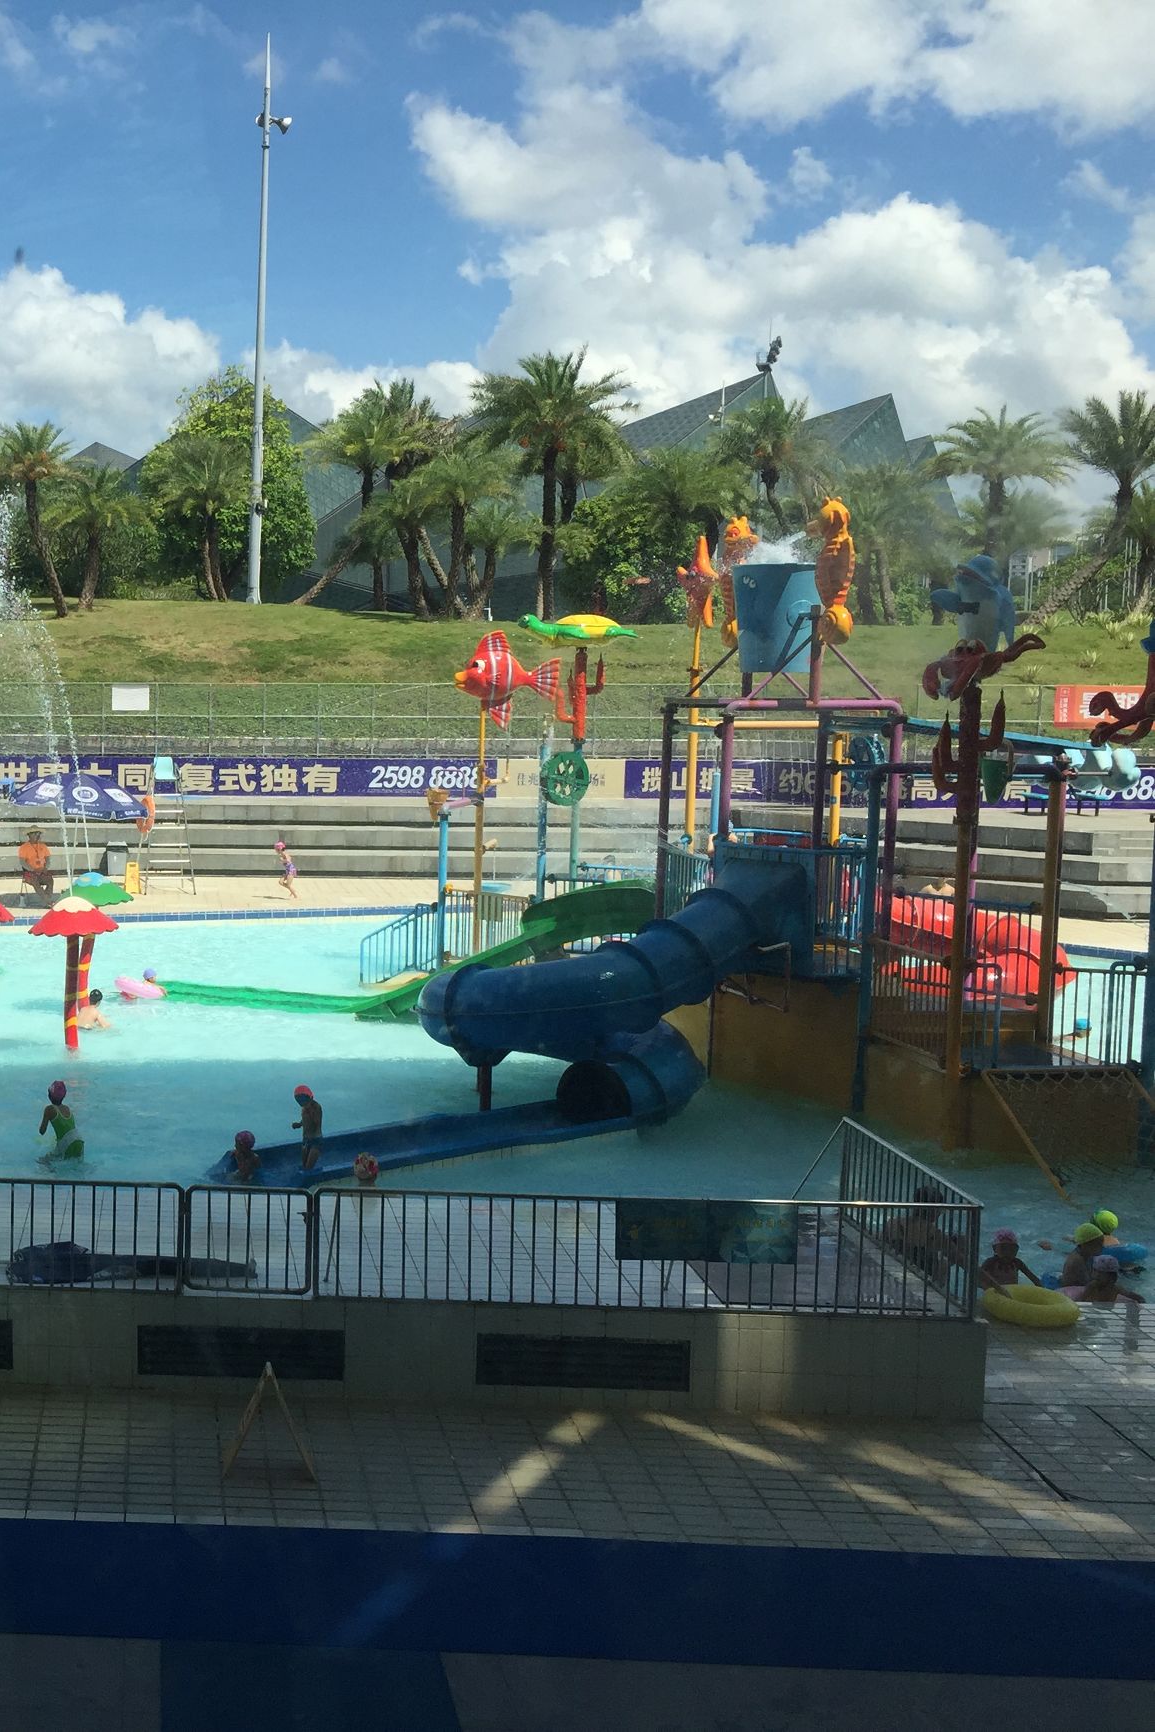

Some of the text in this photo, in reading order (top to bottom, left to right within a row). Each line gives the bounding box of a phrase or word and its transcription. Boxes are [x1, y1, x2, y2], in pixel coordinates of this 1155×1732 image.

[179, 763, 341, 793] 复式独有
[369, 766, 480, 789] 2598 8888
